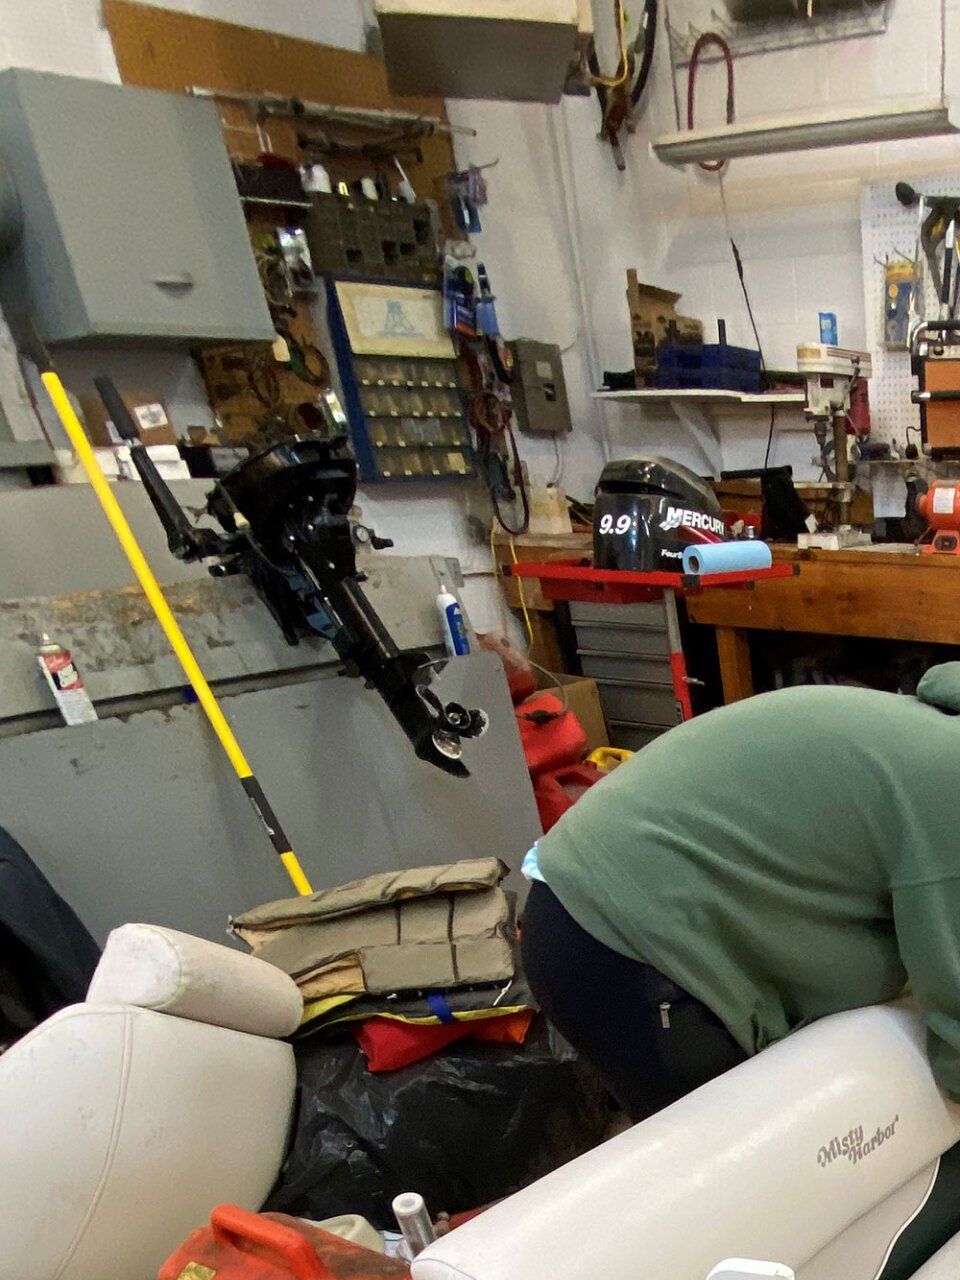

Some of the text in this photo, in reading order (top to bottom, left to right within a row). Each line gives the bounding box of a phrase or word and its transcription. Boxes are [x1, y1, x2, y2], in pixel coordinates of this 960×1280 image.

[599, 514, 632, 535] 9.9
[816, 1124, 864, 1168] Misty
[848, 1120, 896, 1165] Harbor
